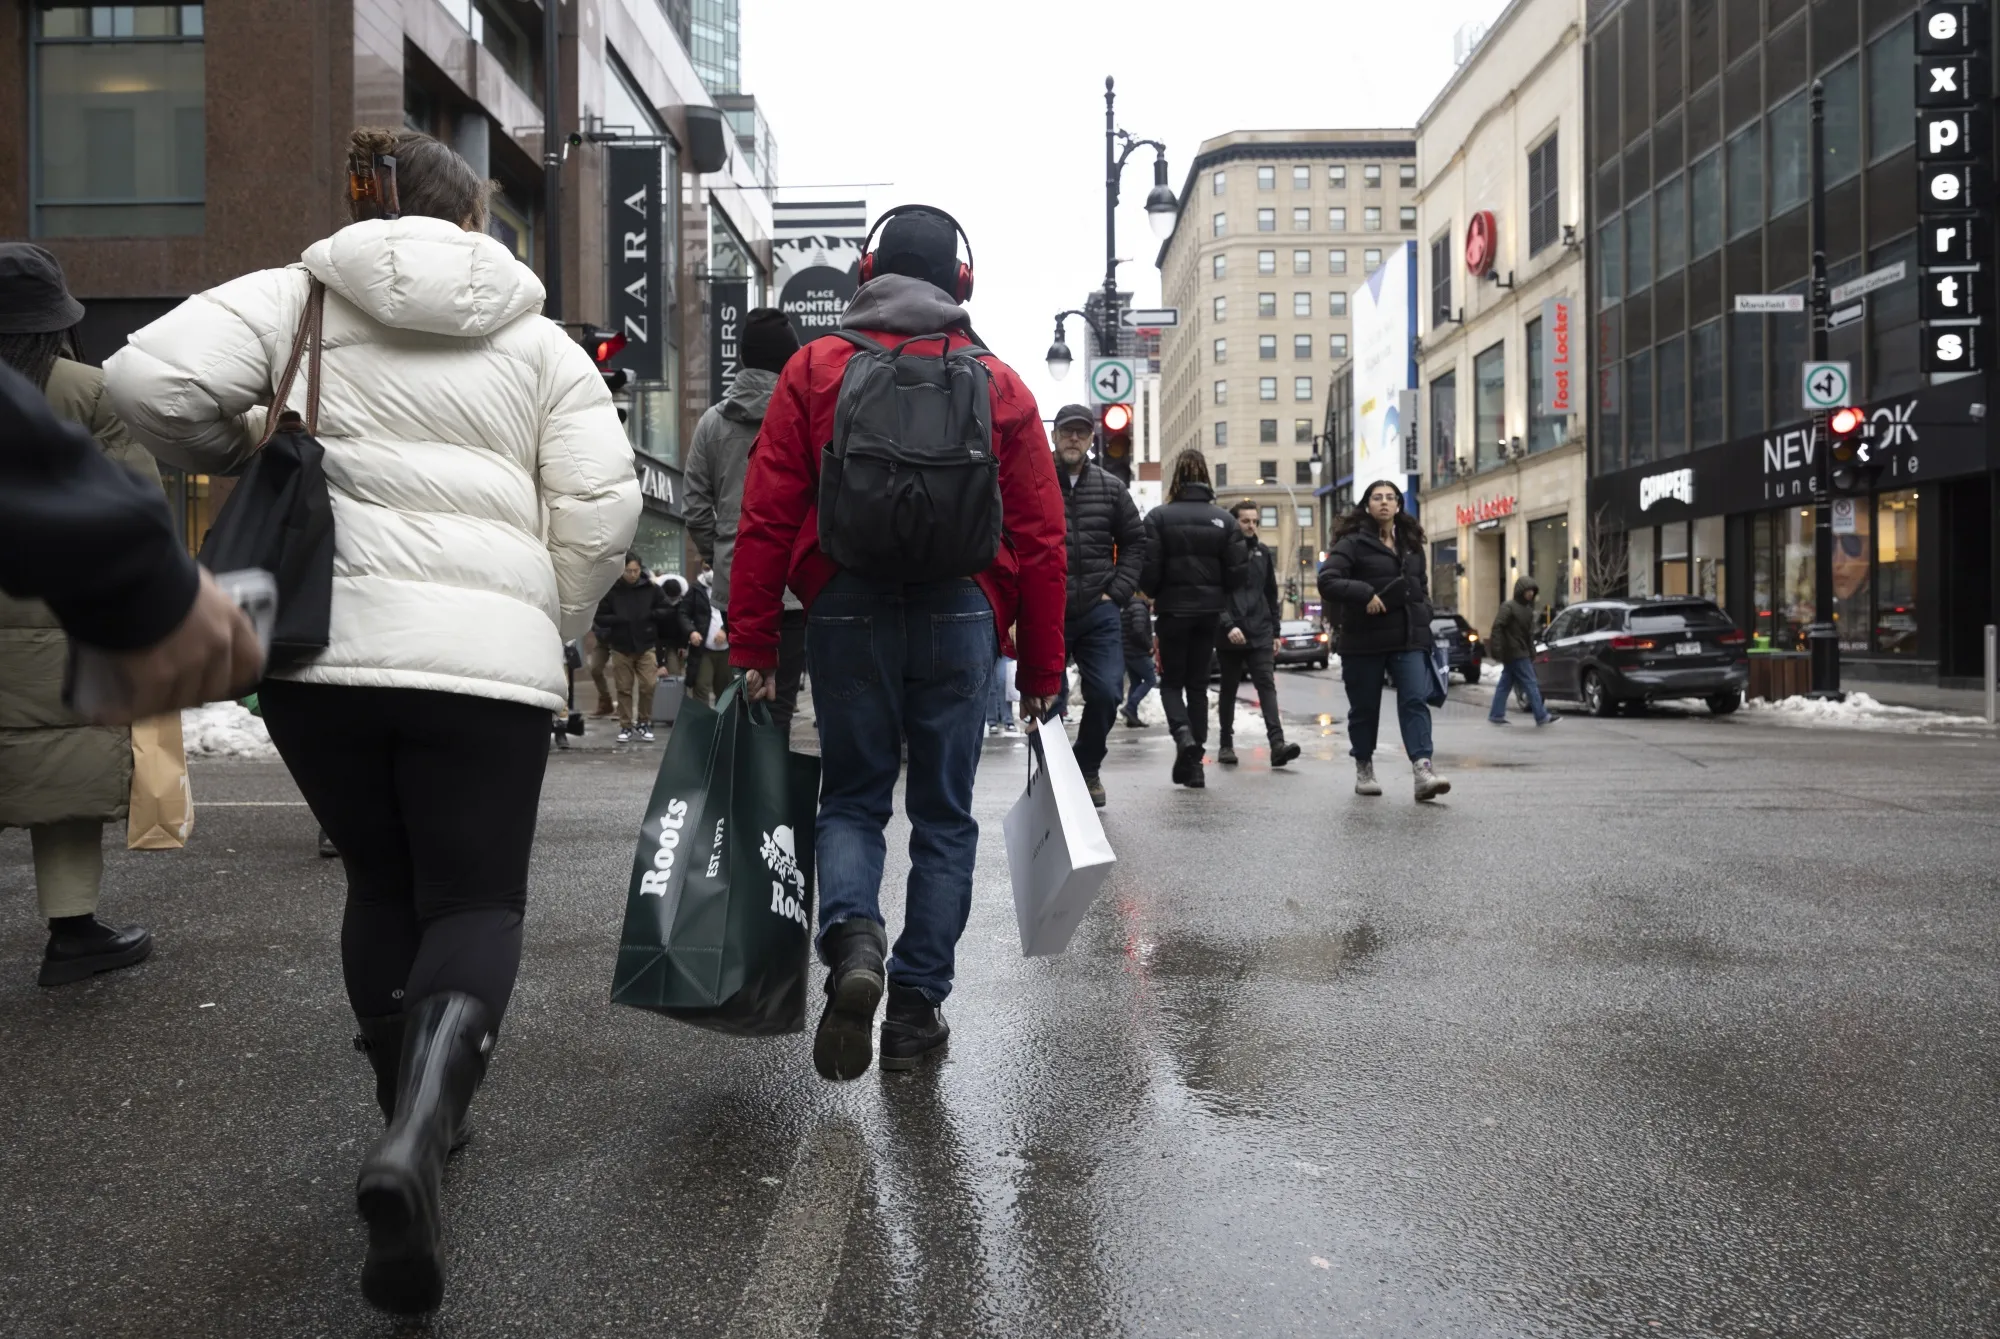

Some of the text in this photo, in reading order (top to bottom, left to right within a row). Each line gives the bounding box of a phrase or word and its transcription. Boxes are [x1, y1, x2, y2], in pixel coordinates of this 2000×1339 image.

[1928, 12, 1963, 361] experts
[624, 184, 647, 343] ZARA
[806, 289, 834, 298] PLACE
[783, 297, 850, 313] MONTRÉA
[799, 314, 842, 327] TRUST
[721, 305, 737, 397] NNERS
[1552, 303, 1569, 409] Foot Locker
[642, 464, 674, 505] ZARA
[1456, 492, 1515, 526] Foot Locker
[640, 798, 688, 897] Roots
[705, 817, 725, 878] EST. 1973
